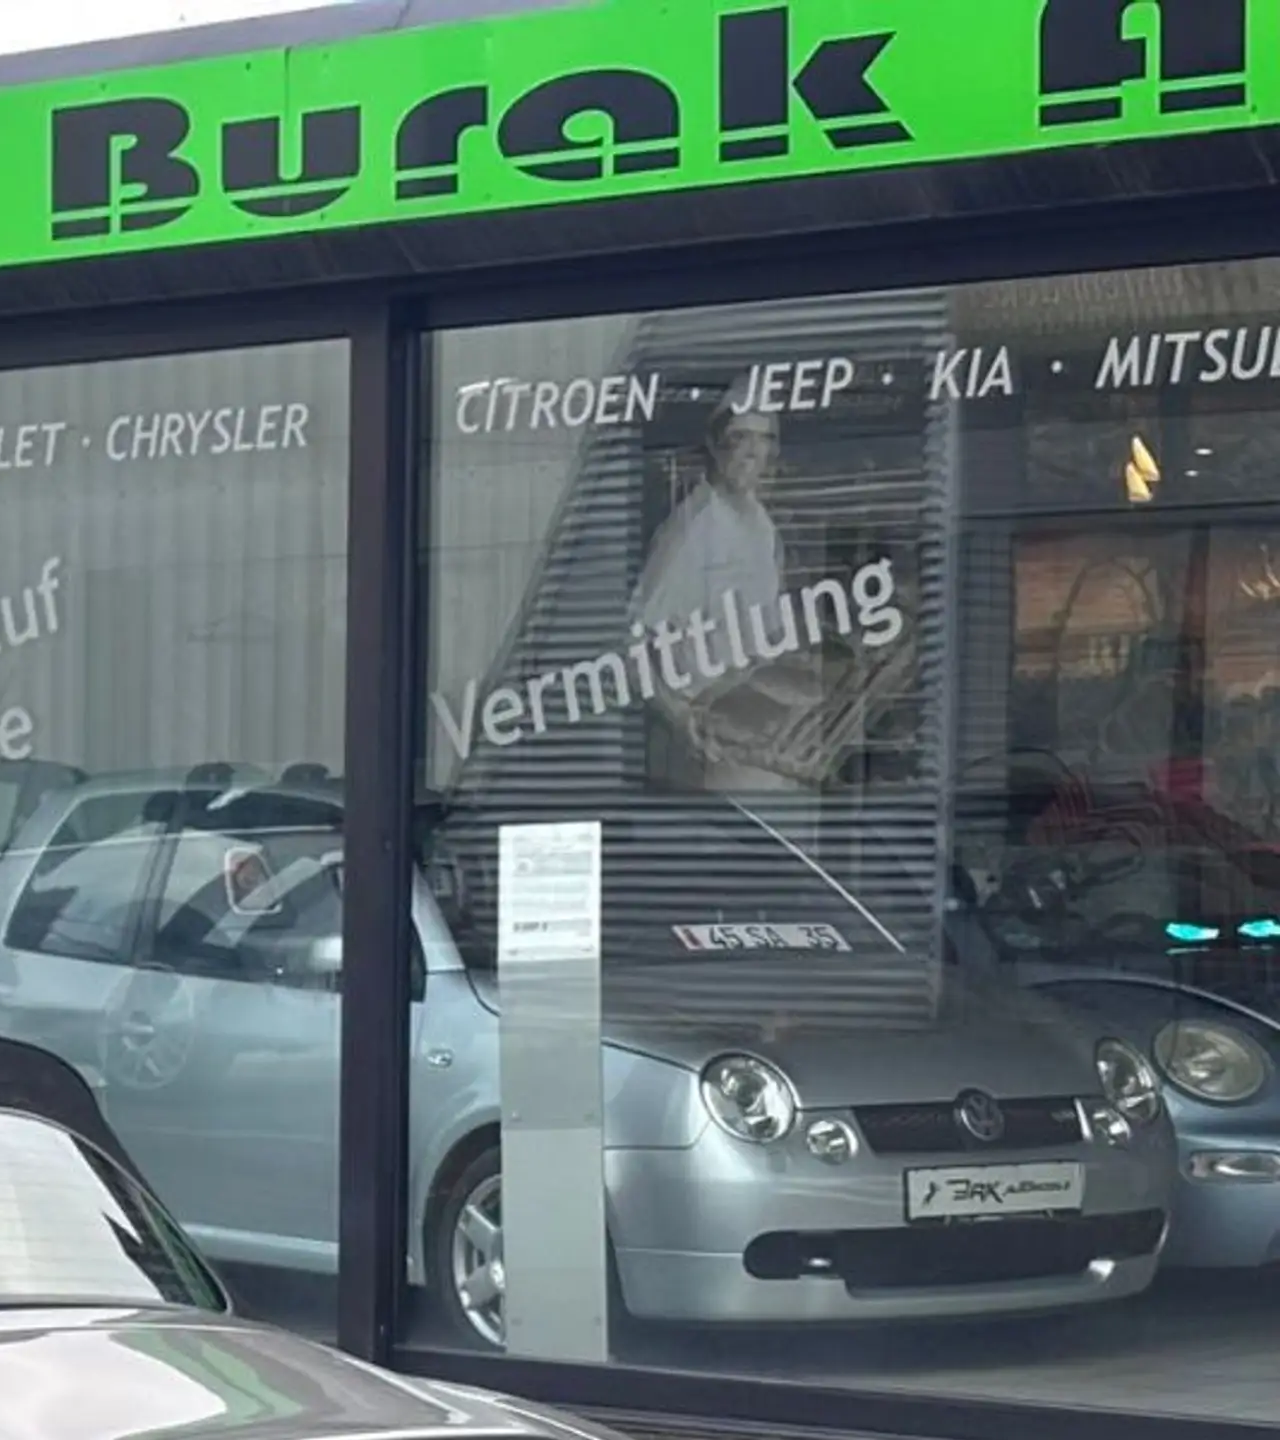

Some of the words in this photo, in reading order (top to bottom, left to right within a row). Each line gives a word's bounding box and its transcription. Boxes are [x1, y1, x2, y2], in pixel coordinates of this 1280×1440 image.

[51, 6, 915, 241] Burak
[106, 402, 309, 461] CHRYSLER
[731, 357, 853, 414] JEEP
[930, 346, 1013, 400] KIA
[429, 556, 904, 760] Vermittlung
